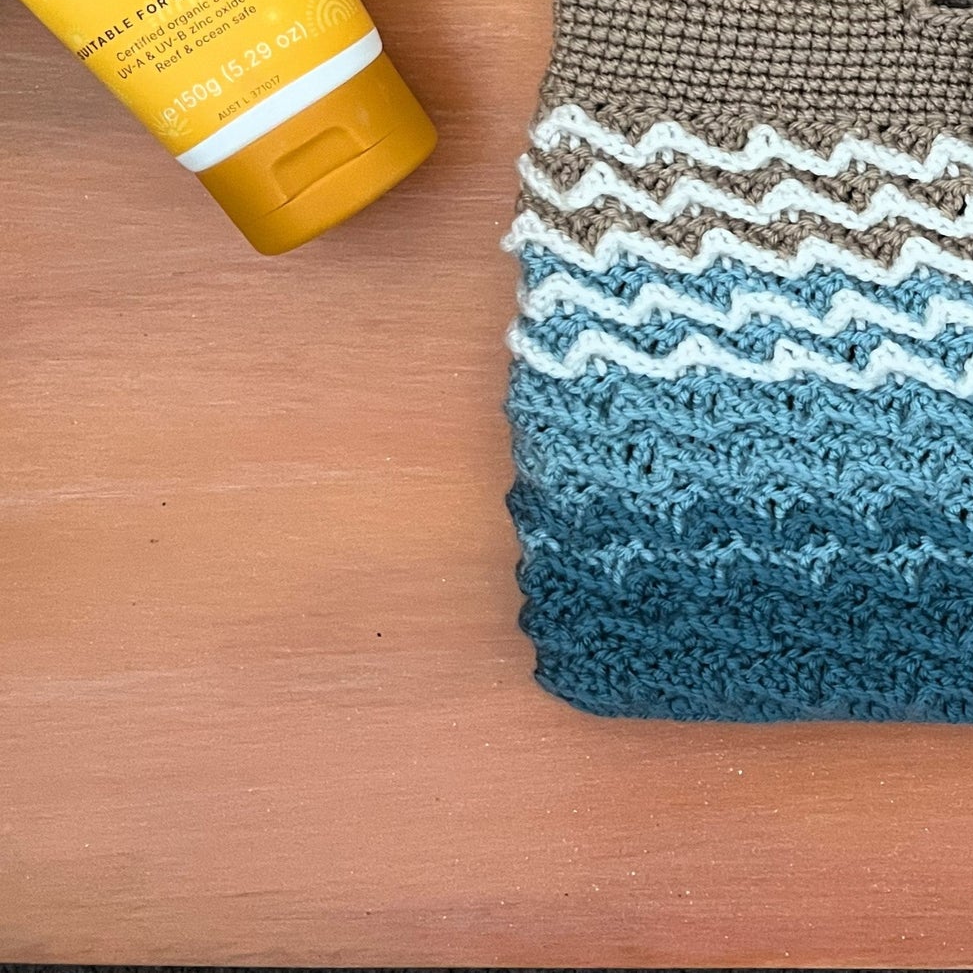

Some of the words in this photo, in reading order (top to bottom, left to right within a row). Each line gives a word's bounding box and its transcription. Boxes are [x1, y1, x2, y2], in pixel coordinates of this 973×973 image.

[116, 27, 165, 62] Certified
[167, 1, 211, 30] organic
[117, 58, 147, 80] UV-A
[145, 51, 156, 62] &
[155, 30, 188, 54] UV-B
[188, 16, 214, 35] zinc
[155, 49, 183, 74] Reef
[183, 44, 194, 55] &
[195, 22, 231, 48] ocean
[232, 5, 257, 26] safe
[221, 41, 273, 83] (5.29
[276, 20, 309, 49] oz)
[217, 100, 242, 121] AUST
[250, 74, 281, 99] 371017
